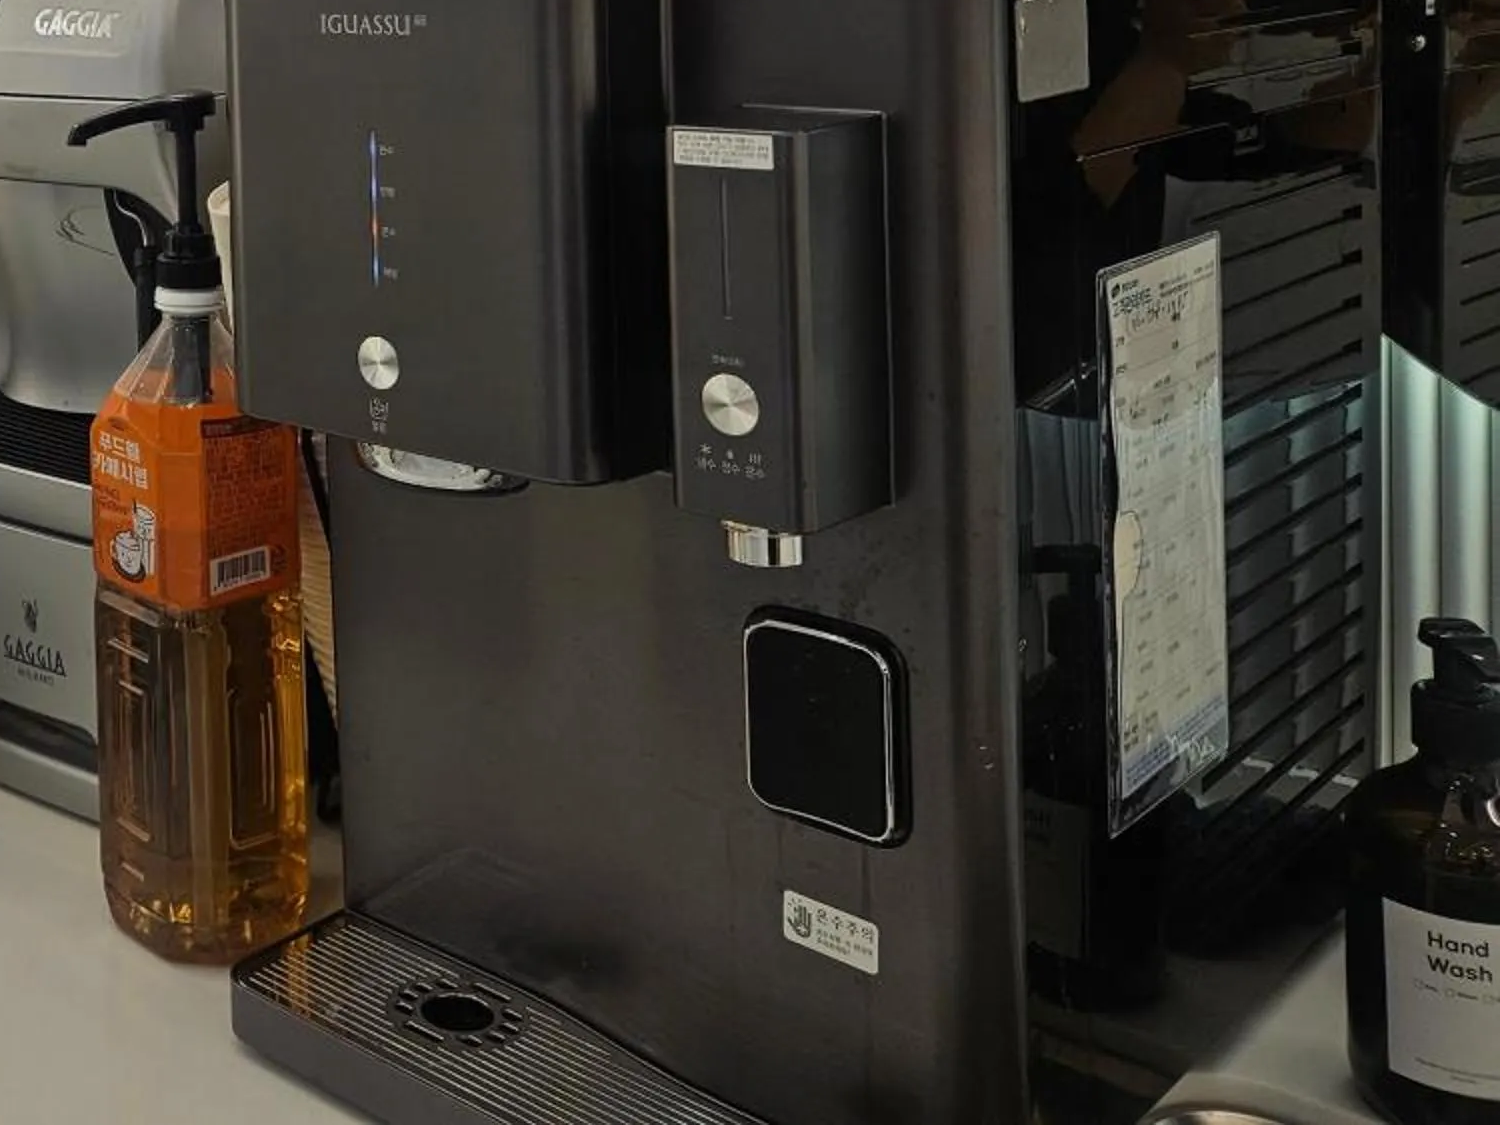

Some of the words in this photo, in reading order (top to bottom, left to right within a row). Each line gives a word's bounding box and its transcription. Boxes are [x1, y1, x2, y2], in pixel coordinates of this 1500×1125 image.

[34, 7, 113, 39] GAGGIA
[320, 13, 411, 36] IGUASSU
[3, 633, 68, 678] GAGGIA
[1427, 930, 1490, 959] Hand
[1427, 954, 1493, 983] Wash
